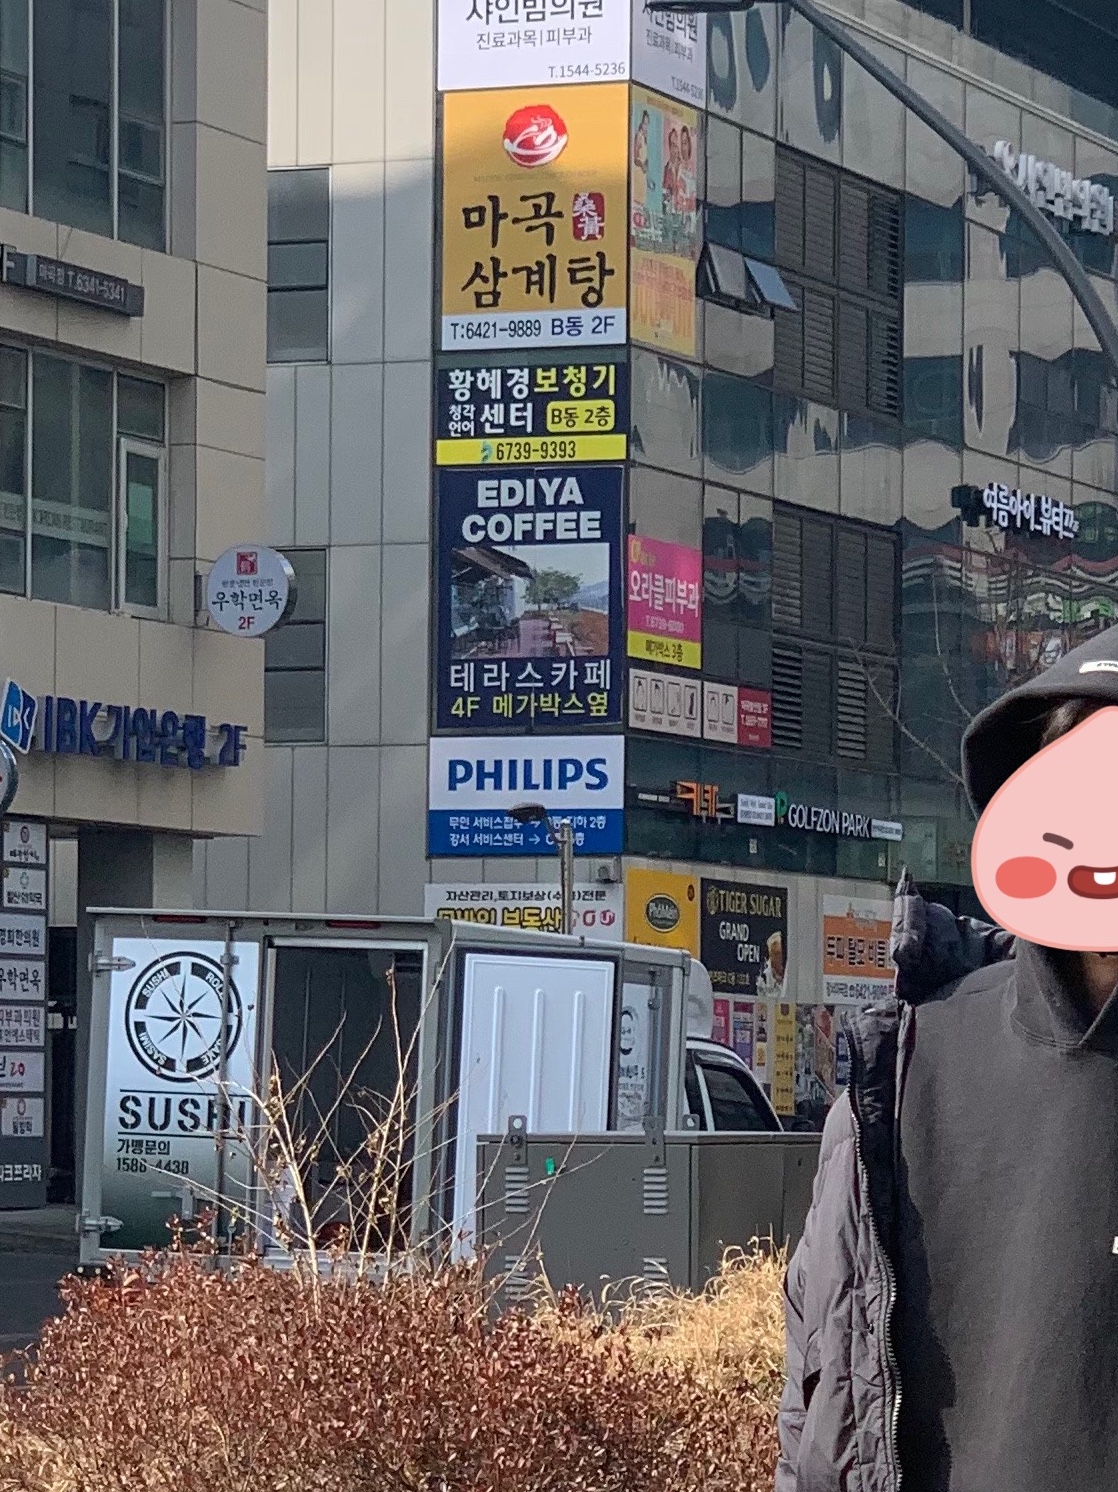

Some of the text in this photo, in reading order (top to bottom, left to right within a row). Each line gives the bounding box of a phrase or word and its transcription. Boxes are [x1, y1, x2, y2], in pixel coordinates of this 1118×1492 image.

[548, 62, 626, 79] T.1544-5236
[461, 191, 564, 249] 마곡
[461, 251, 616, 309] 삼계탕
[450, 315, 616, 340] T:6421-9889 B동 2F
[479, 402, 612, 435] 센터 B동 2층
[495, 441, 577, 461] 6739-9393
[477, 476, 585, 509] EDIYA
[461, 510, 602, 543] COFFEE
[211, 589, 283, 612] 우학면옥
[628, 570, 699, 618] 오라클피부과
[237, 615, 256, 630] 2F
[450, 658, 612, 693] 테라스카페
[451, 690, 609, 719] 4F 메가박스옆
[447, 757, 609, 792] PHILIPS
[449, 816, 470, 830] 무인
[788, 803, 840, 834] GOLFZON
[841, 813, 871, 838] PARK
[449, 833, 470, 847] 강서
[472, 833, 524, 847] 서비스센터
[719, 891, 783, 918] TIGER SUGAR
[719, 921, 750, 942] GRAND
[736, 943, 760, 962] OPEN
[141, 968, 171, 998] SUSHI
[118, 1095, 246, 1133] SUSHI
